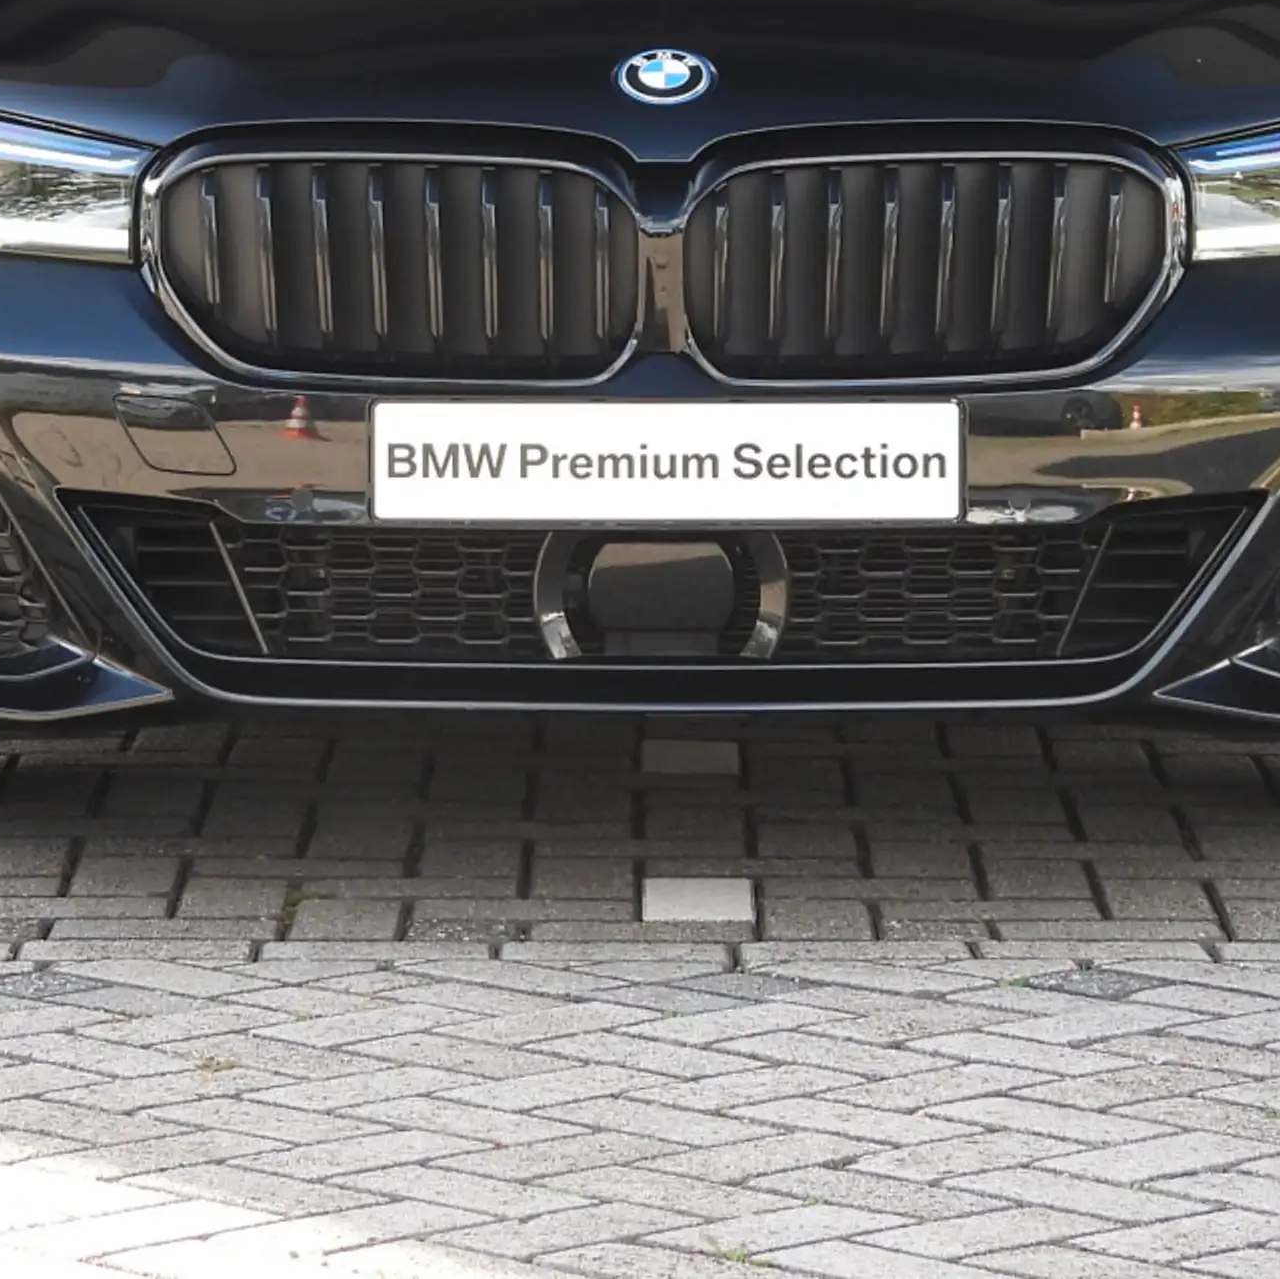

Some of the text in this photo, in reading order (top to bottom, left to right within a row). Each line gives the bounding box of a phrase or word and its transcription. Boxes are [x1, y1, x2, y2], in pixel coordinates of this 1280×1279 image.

[387, 442, 947, 480] BMW Premium Selection
